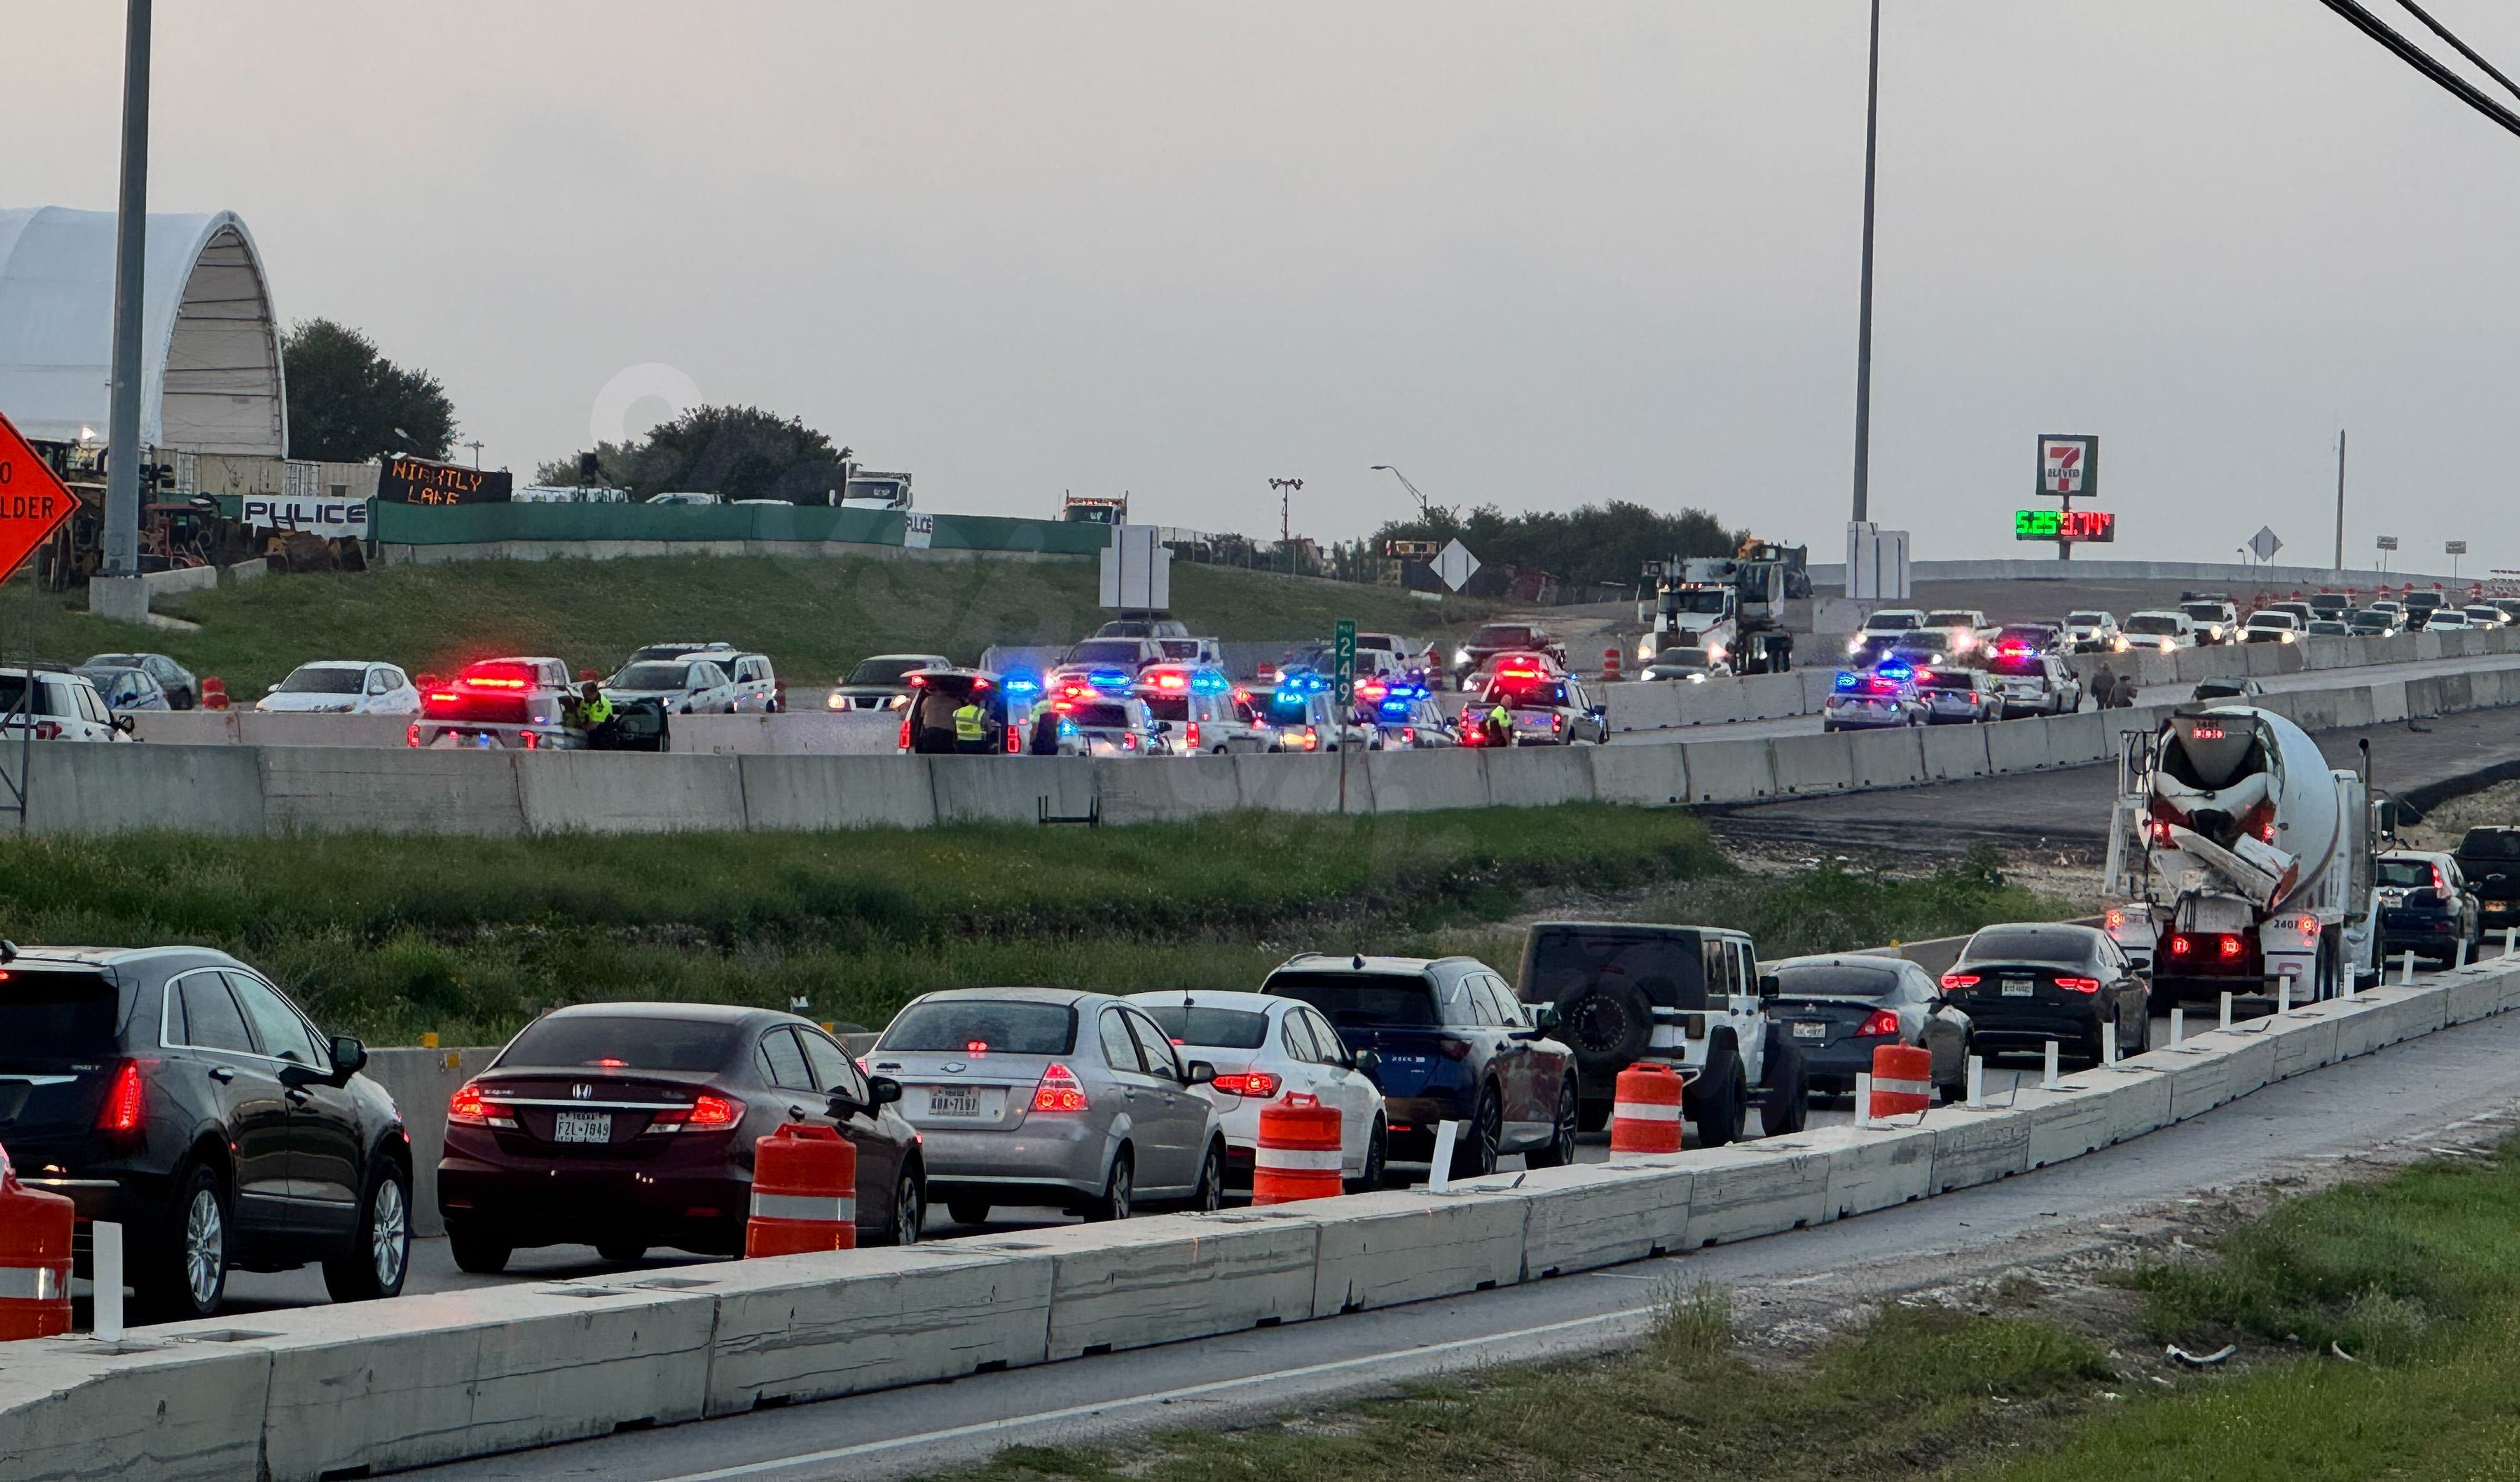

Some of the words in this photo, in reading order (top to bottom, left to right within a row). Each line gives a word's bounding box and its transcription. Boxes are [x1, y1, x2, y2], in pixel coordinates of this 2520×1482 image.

[0, 462, 12, 484] O
[2049, 447, 2080, 491] 7
[0, 496, 54, 519] LDER
